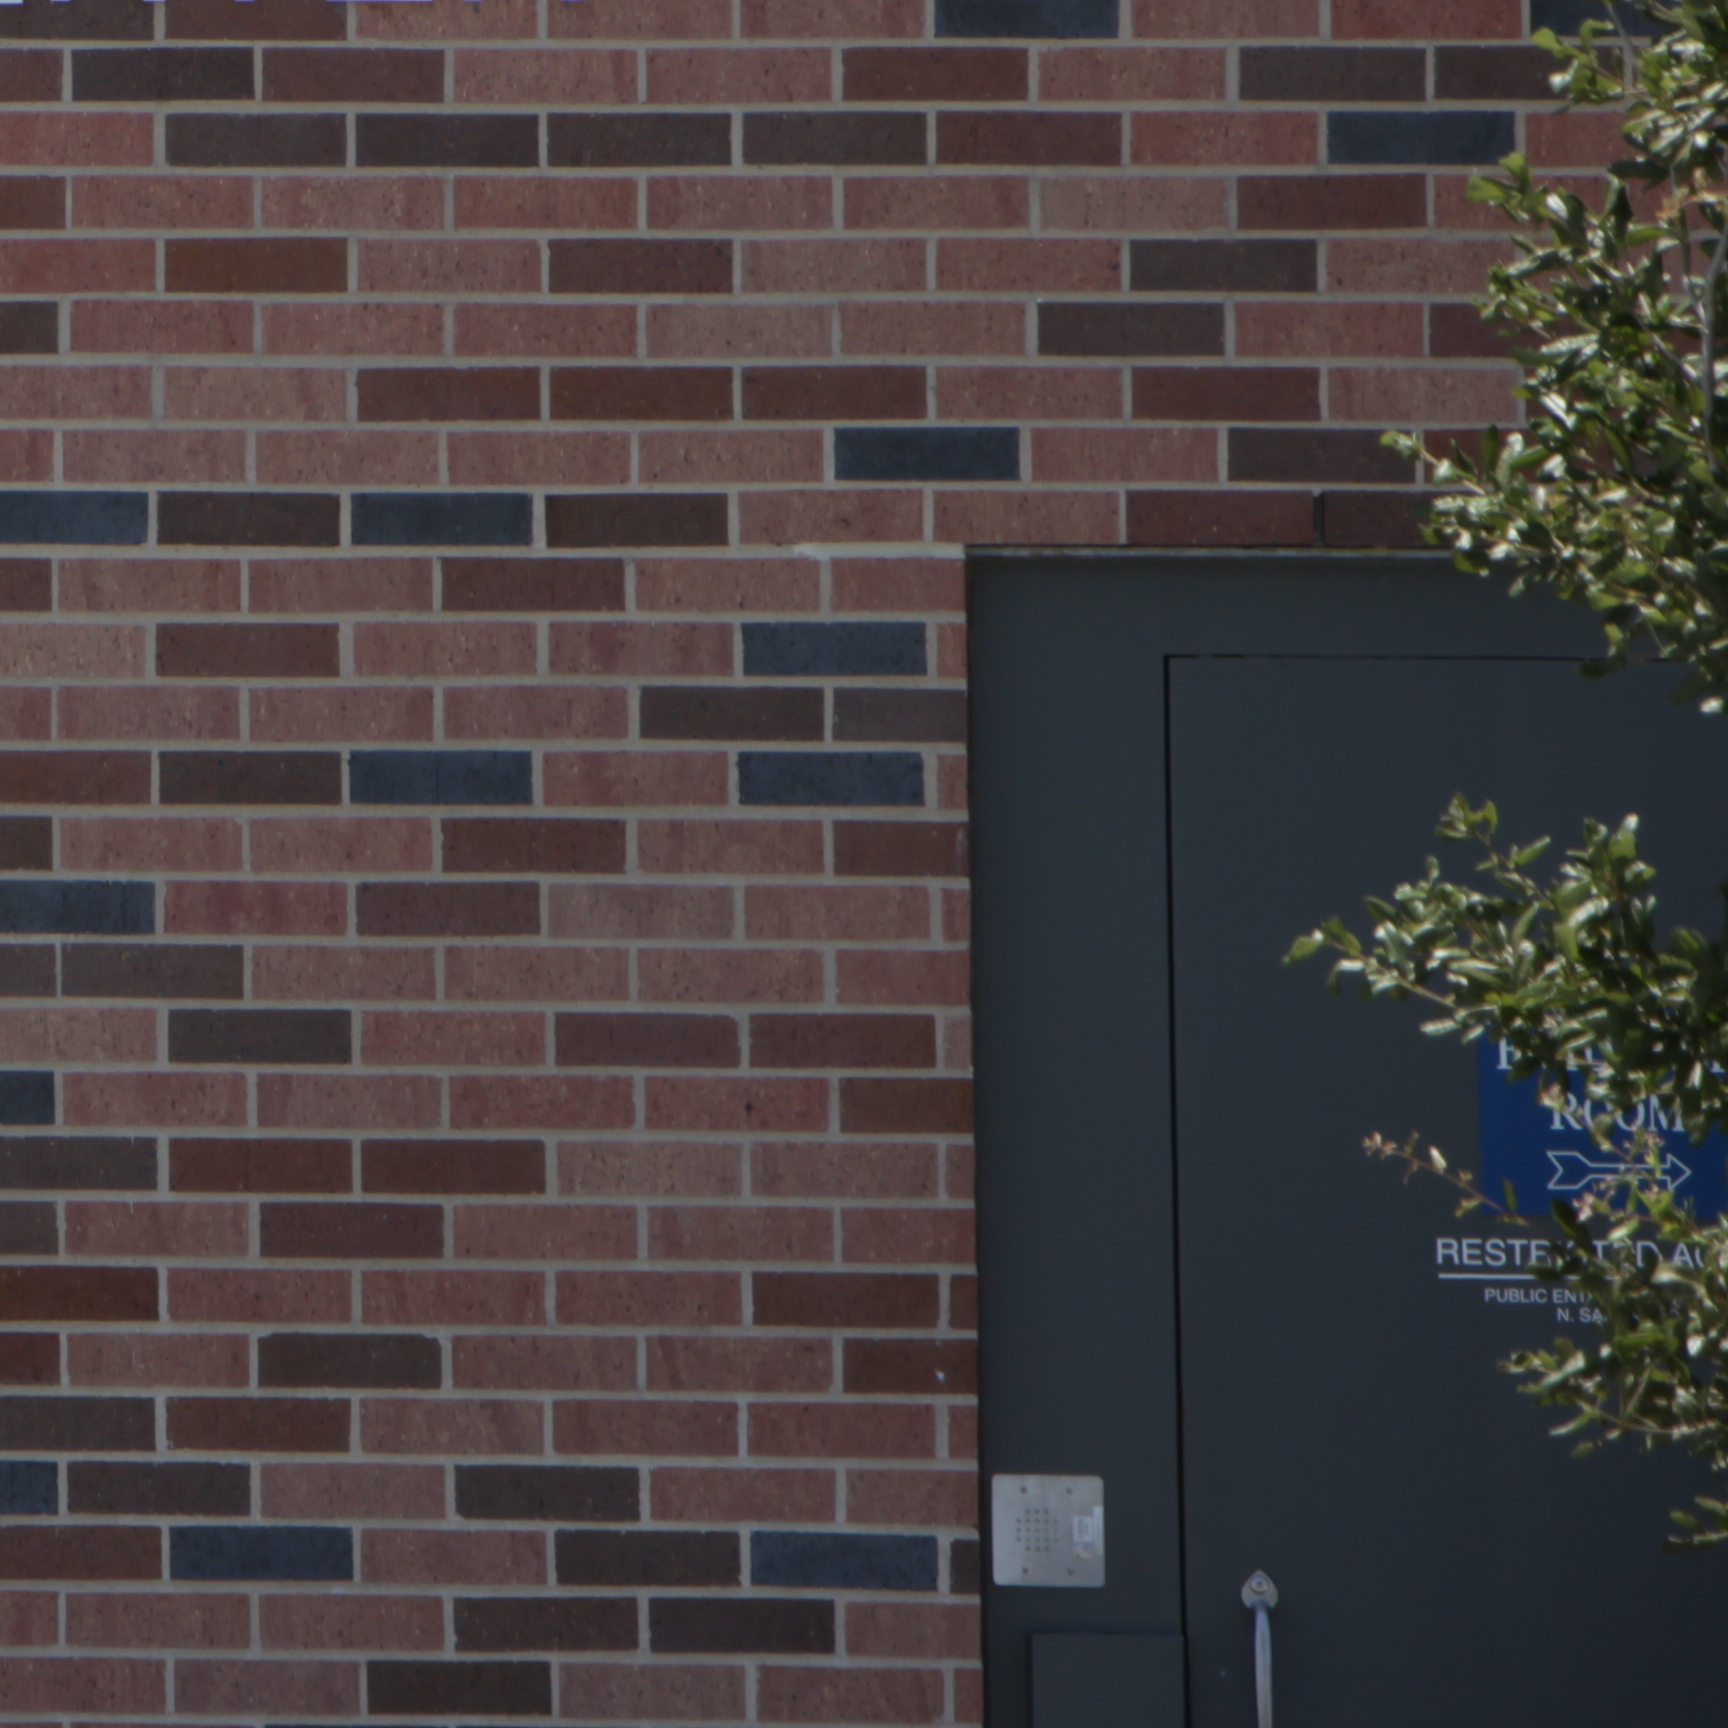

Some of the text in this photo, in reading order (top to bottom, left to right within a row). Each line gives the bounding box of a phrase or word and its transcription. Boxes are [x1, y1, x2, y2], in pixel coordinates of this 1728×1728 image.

[1436, 1237, 1663, 1269] RESTRTD
[1484, 1287, 1547, 1303] PUBLIC
[1556, 1307, 1574, 1322] N.
